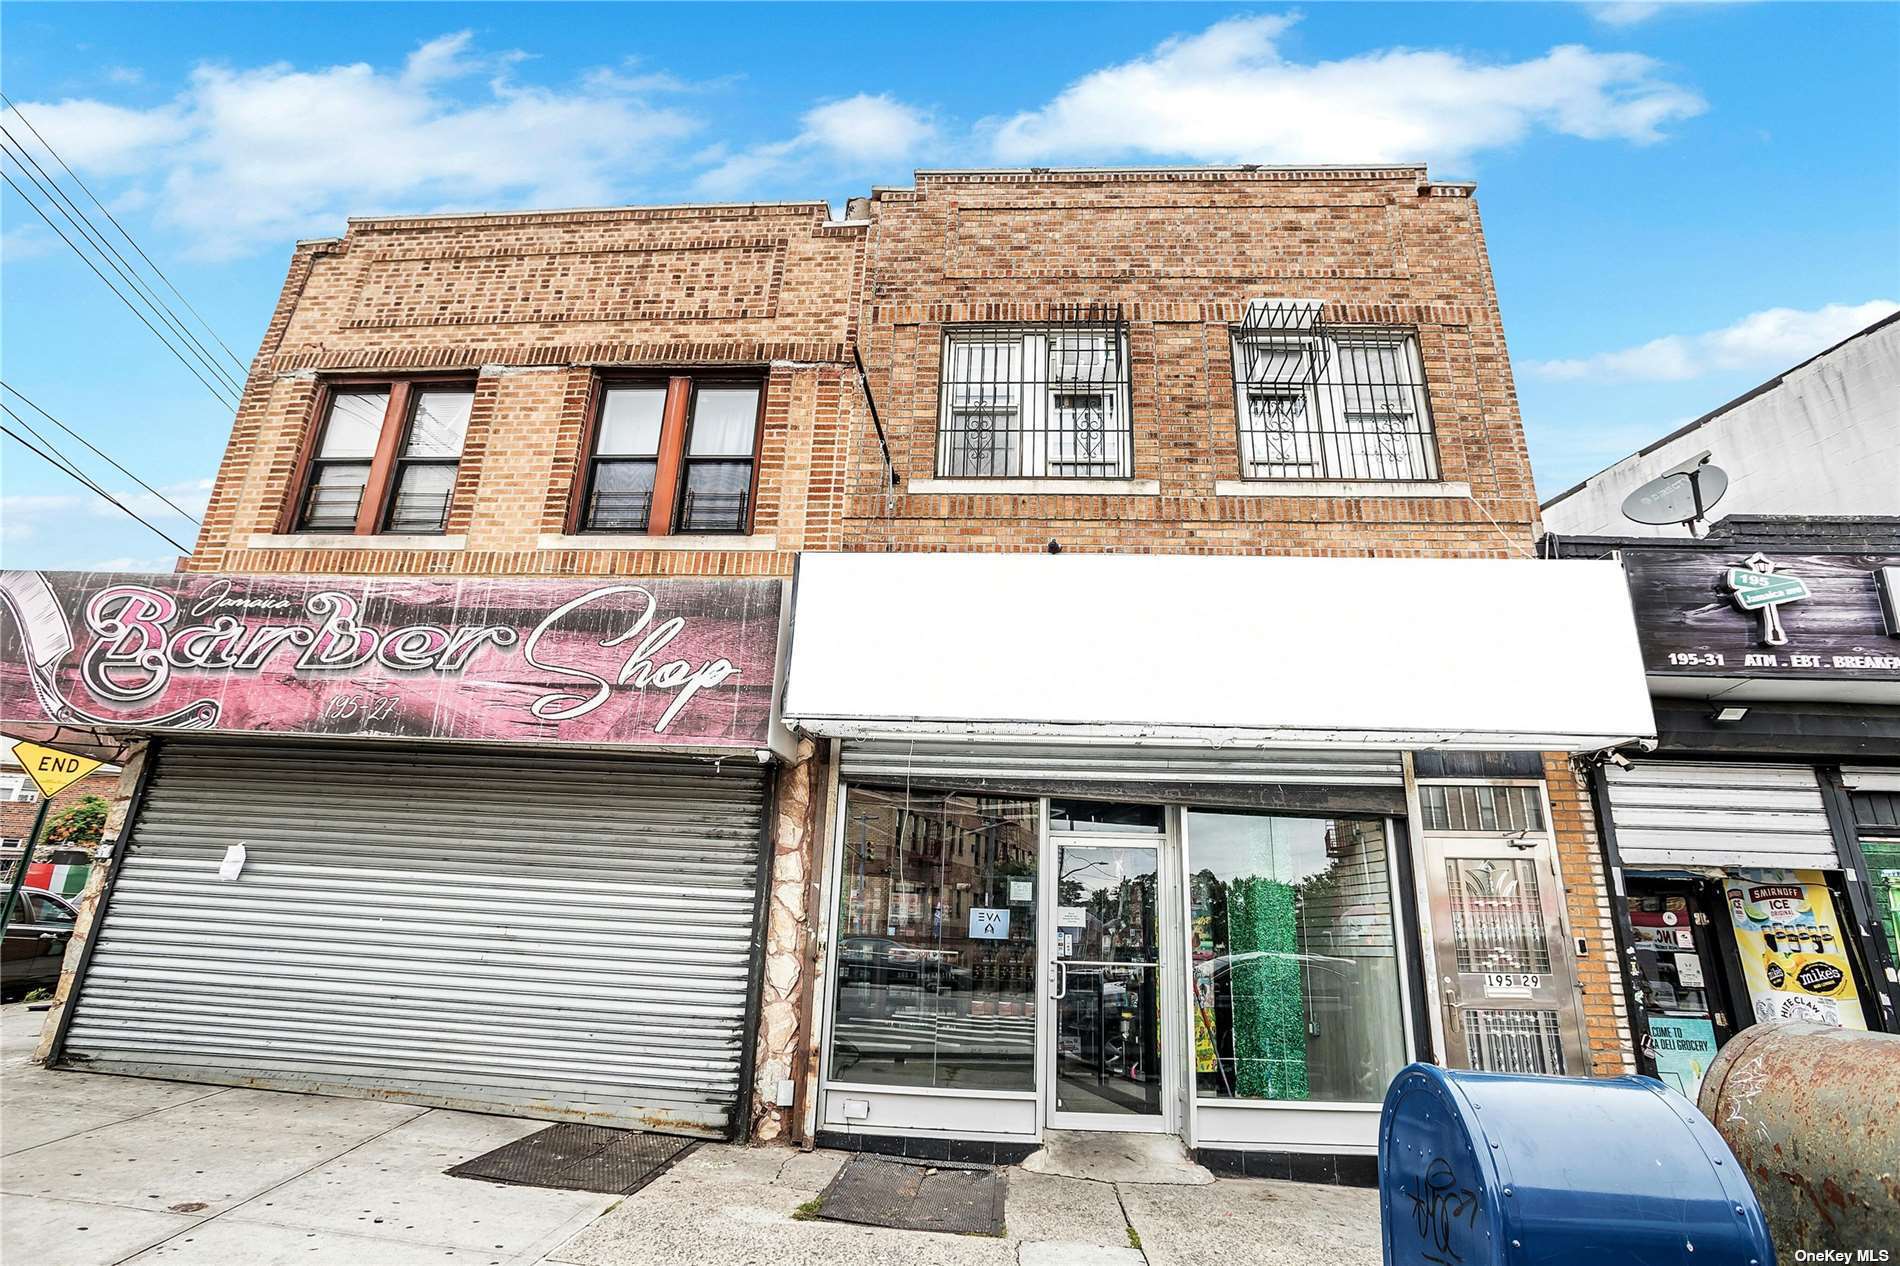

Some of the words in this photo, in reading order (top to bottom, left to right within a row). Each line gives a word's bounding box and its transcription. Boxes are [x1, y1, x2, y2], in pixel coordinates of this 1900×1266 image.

[1739, 574, 1770, 587] 195
[191, 579, 292, 617] Jamaica
[82, 583, 519, 701] Barber
[524, 584, 743, 733] Shop
[1667, 652, 1726, 666] 195-31
[1743, 653, 1778, 667] ATM
[1789, 654, 1822, 668] EBT
[325, 694, 400, 720] 195-27
[38, 756, 80, 773] END
[1753, 887, 1799, 899] SMIRNOFF
[1769, 899, 1790, 910] ICE
[1487, 974, 1513, 987] 195
[1522, 975, 1539, 987] 29
[1799, 967, 1841, 986] mike's
[1793, 996, 1821, 1014] CLAW
[1673, 1027, 1683, 1039] TO
[1660, 1039, 1676, 1050] DELI
[1676, 1039, 1708, 1052] GROCERY
